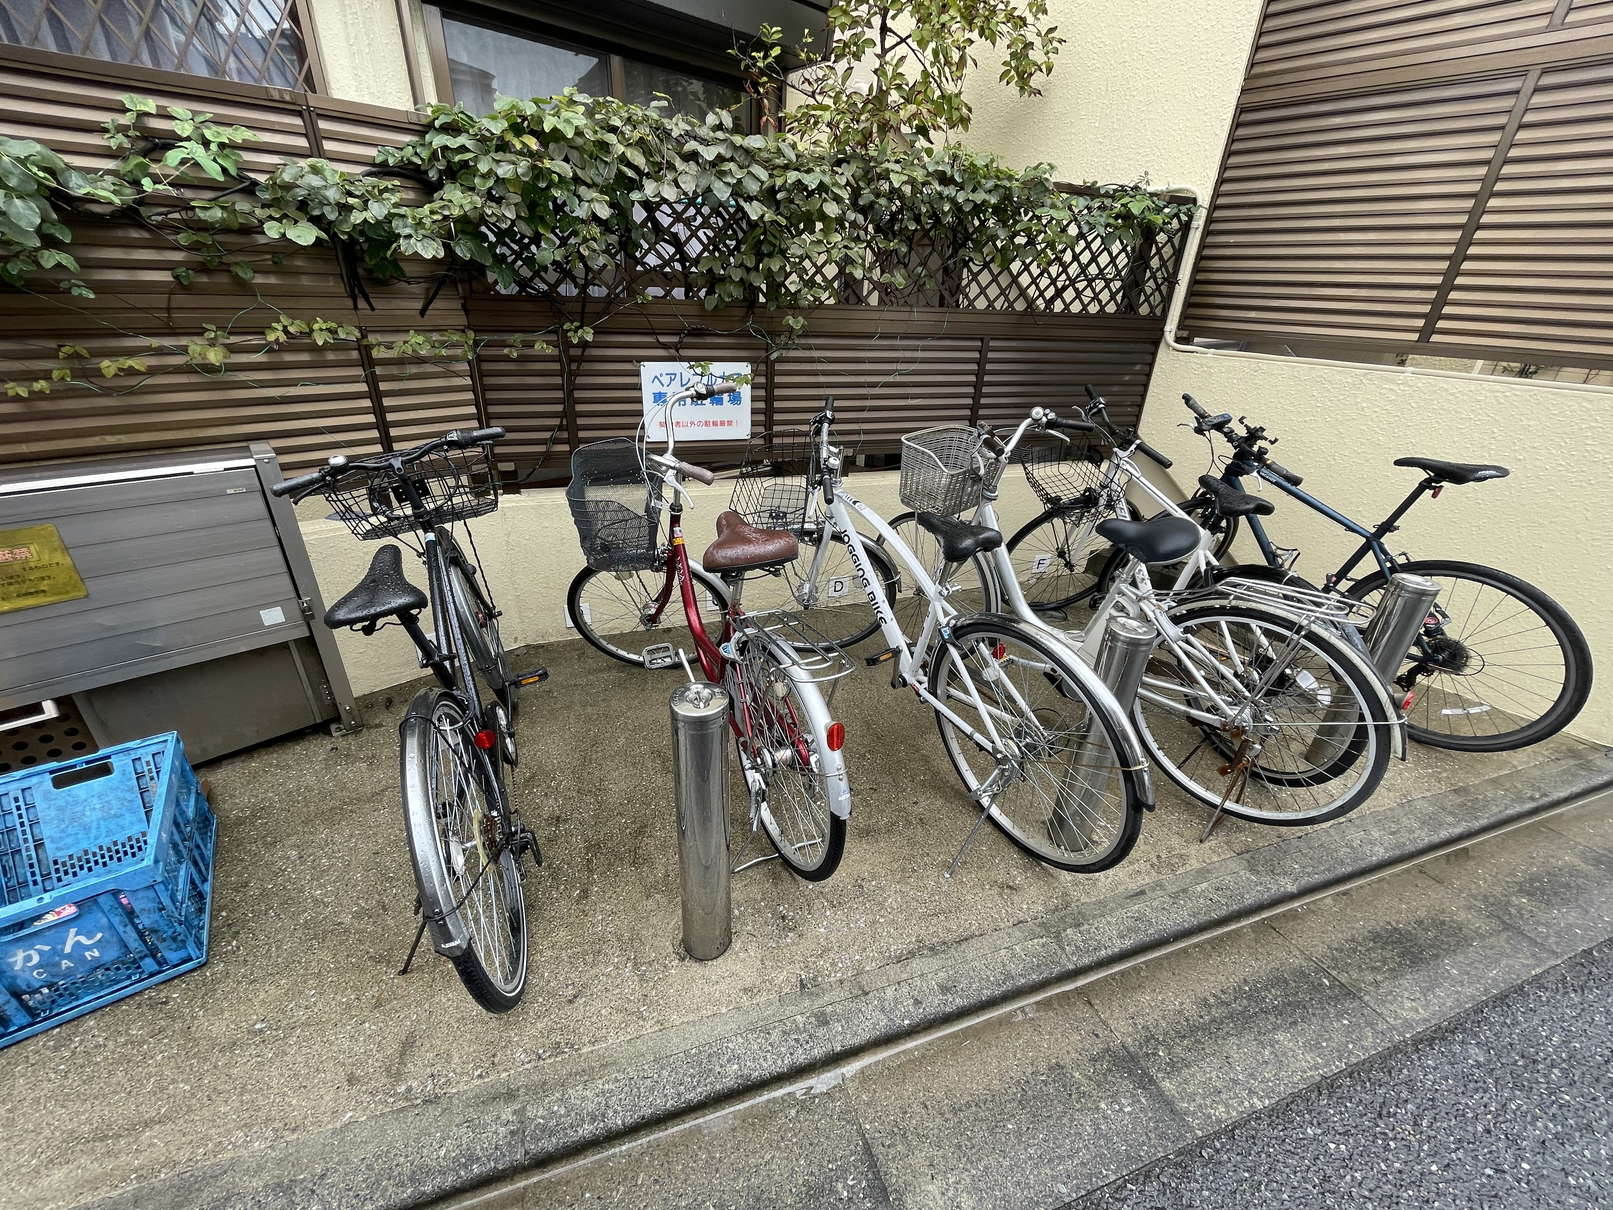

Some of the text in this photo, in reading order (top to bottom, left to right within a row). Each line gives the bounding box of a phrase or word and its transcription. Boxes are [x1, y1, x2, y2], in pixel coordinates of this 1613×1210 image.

[840, 528, 888, 625] JOGGING BIKE
[1036, 558, 1048, 570] F
[833, 580, 845, 593] D
[7, 927, 104, 971] かん
[32, 948, 101, 980] CAN
